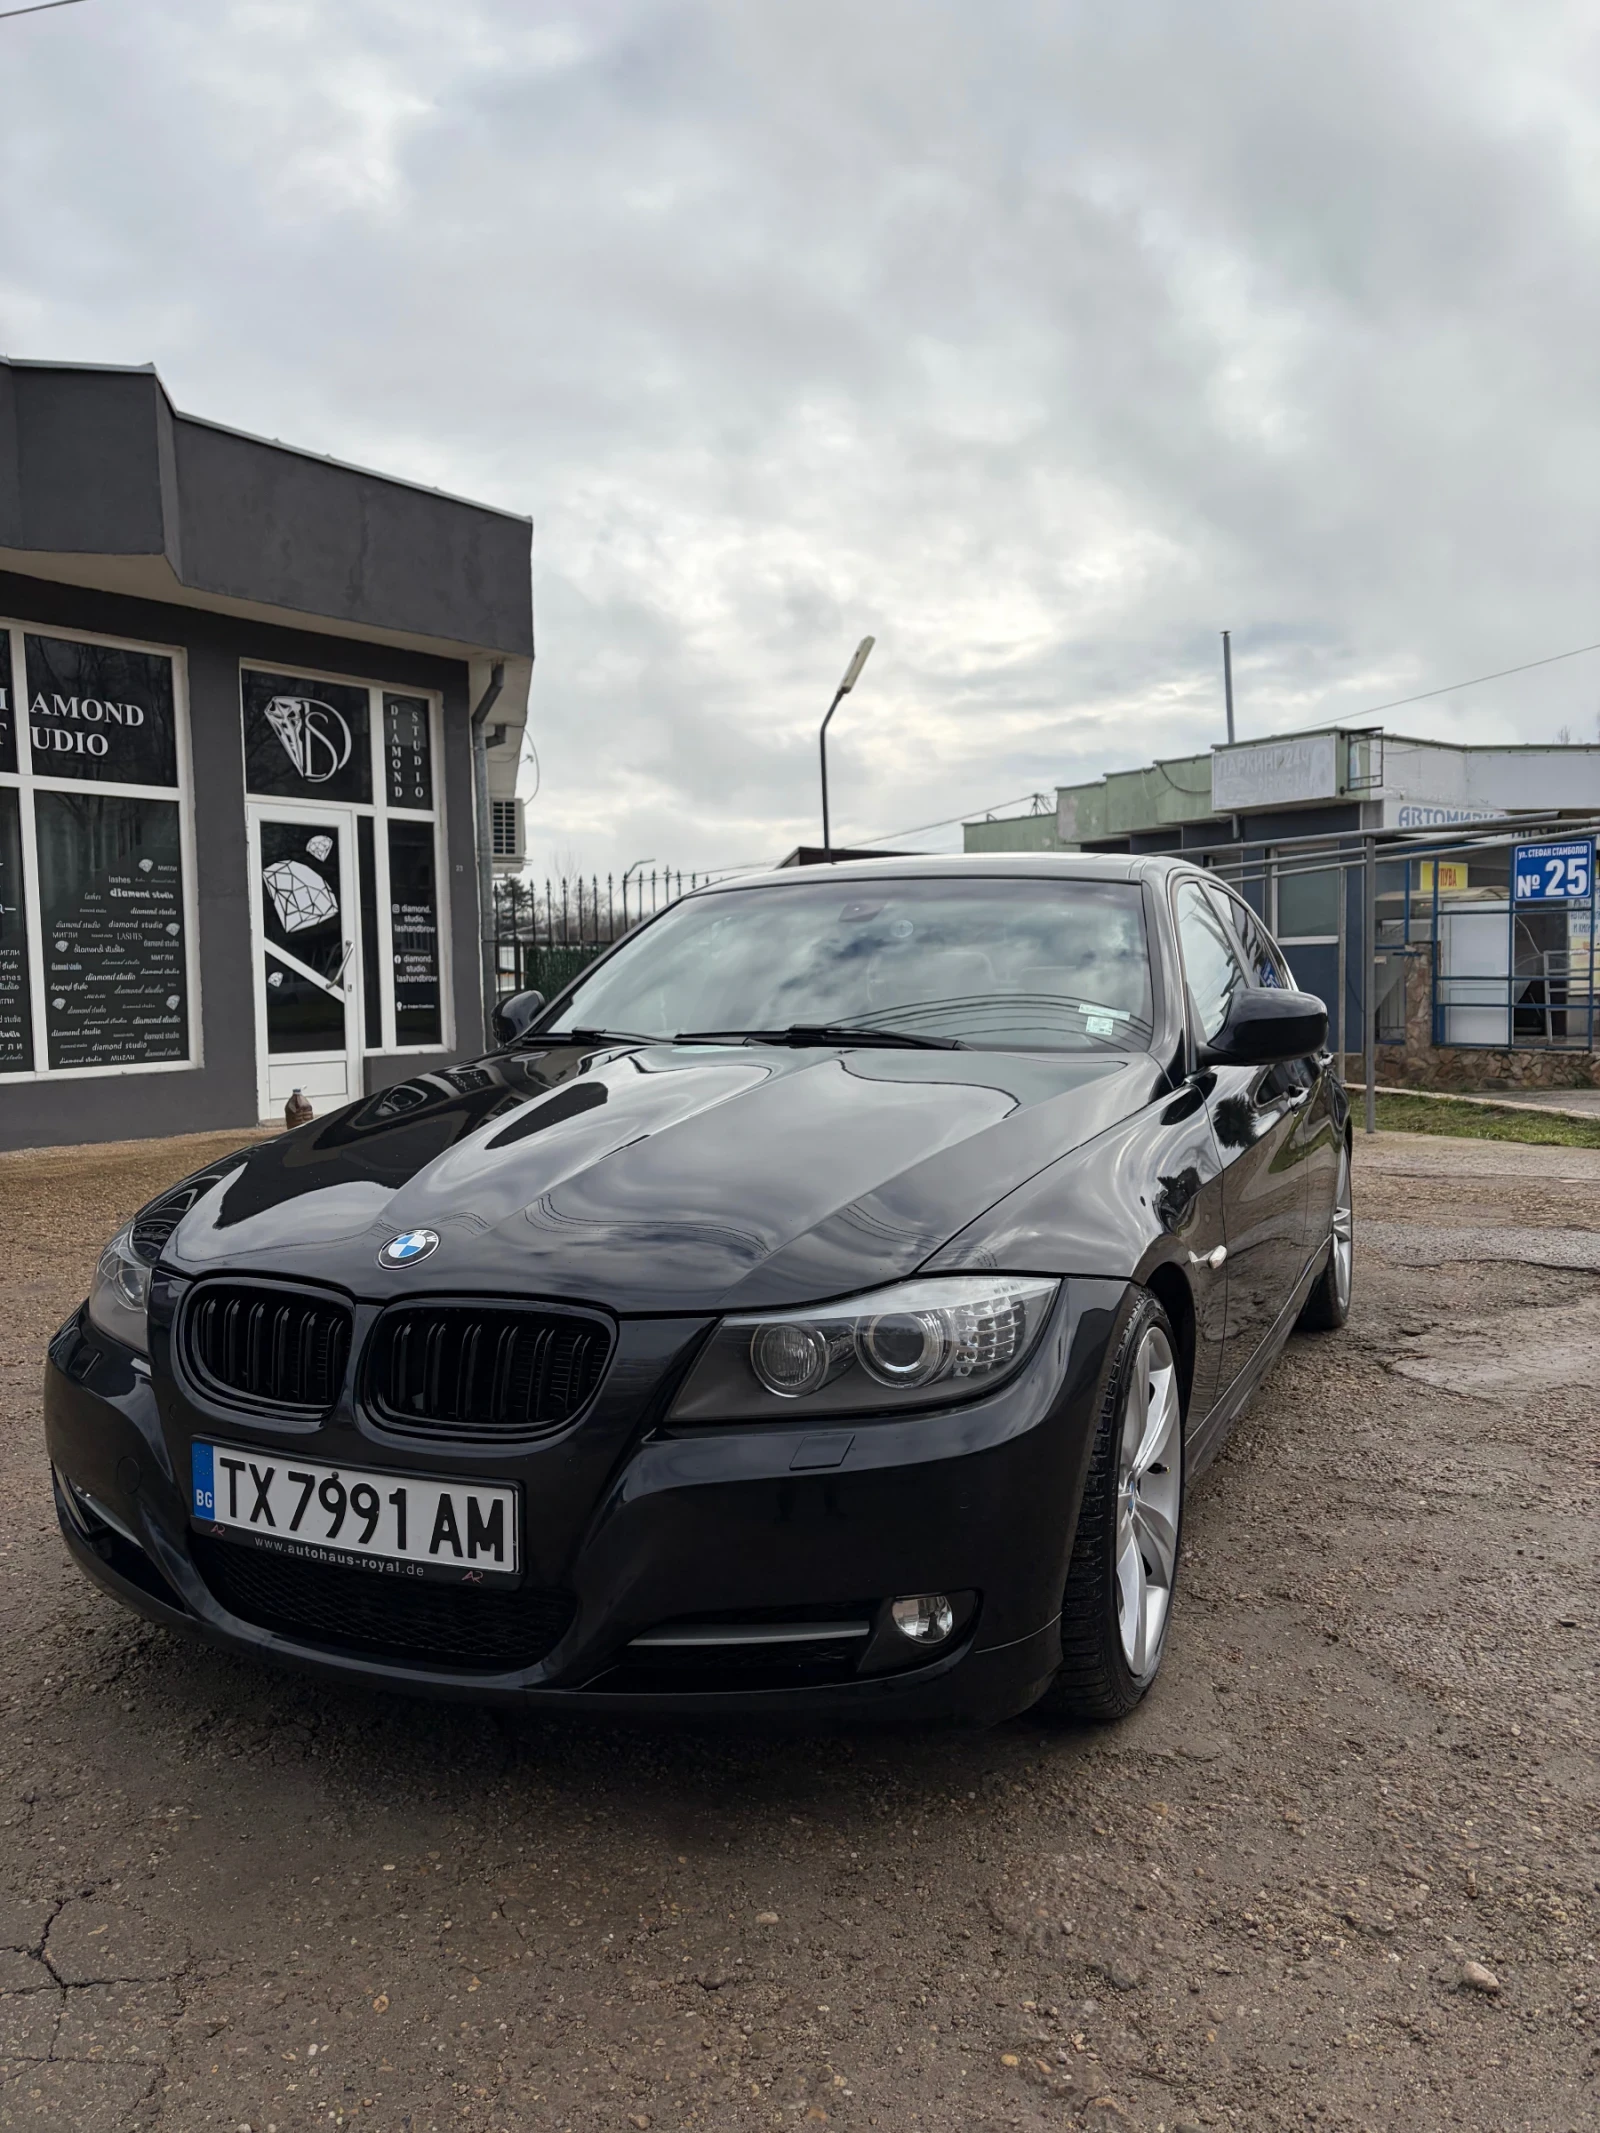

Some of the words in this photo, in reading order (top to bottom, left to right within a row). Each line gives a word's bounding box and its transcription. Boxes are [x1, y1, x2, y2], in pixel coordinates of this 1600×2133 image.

[390, 704, 403, 798] DIAMOND
[412, 712, 424, 798] STUDIO
[1518, 851, 1528, 861] ул.
[1528, 848, 1552, 858] СТЕФАН
[1552, 845, 1588, 857] СТАМБОЛОВ
[1544, 858, 1588, 896] 25
[395, 924, 436, 933] lashandbrow
[397, 974, 438, 983] lashandbrow
[196, 1488, 213, 1509] BG
[288, 1471, 407, 1550] 7991
[429, 1493, 504, 1562] AM
[254, 1536, 424, 1577] www.autohaus-royal.de
